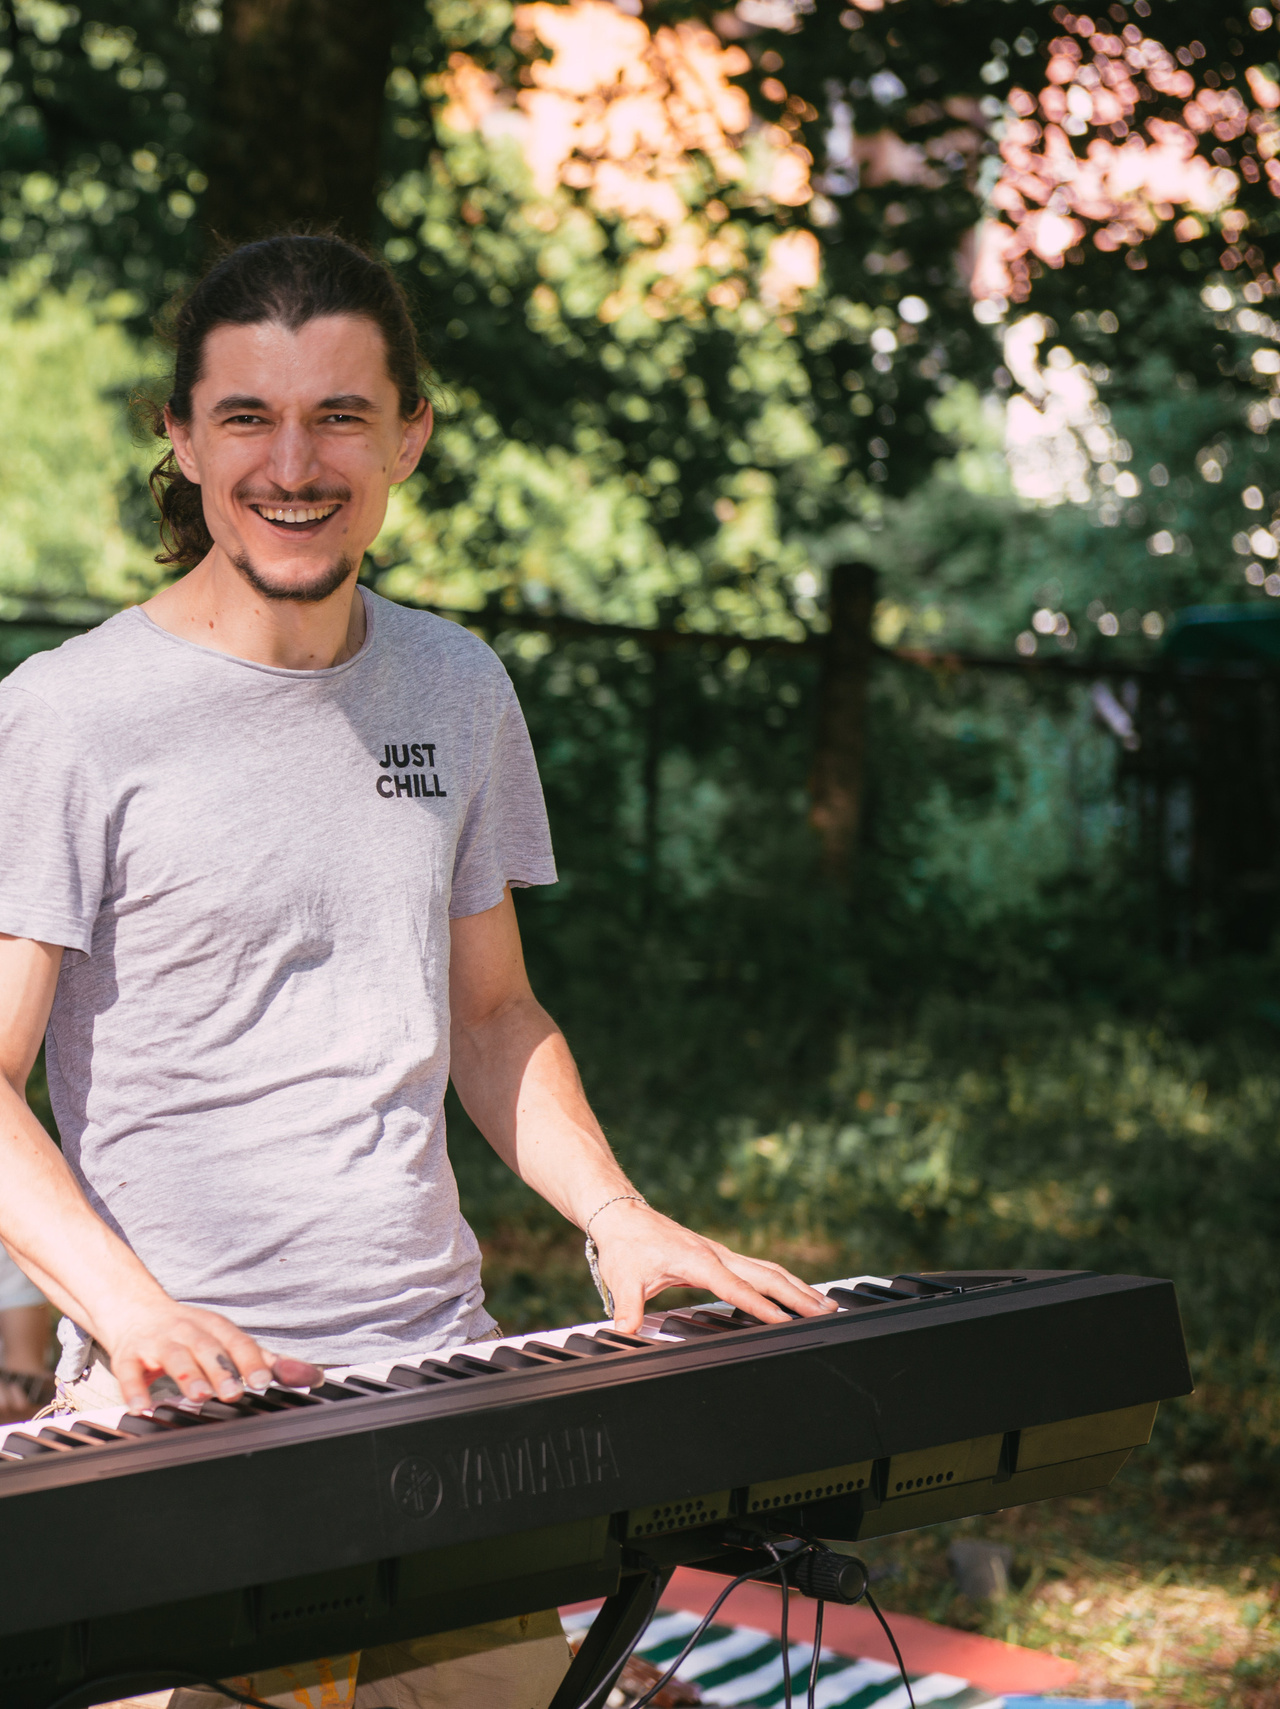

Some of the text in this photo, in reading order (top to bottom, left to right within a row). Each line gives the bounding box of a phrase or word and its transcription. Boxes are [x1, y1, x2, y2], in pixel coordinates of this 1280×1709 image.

[379, 743, 436, 769] JUST
[376, 774, 447, 799] CHILL
[445, 1422, 620, 1509] YAMAHA
